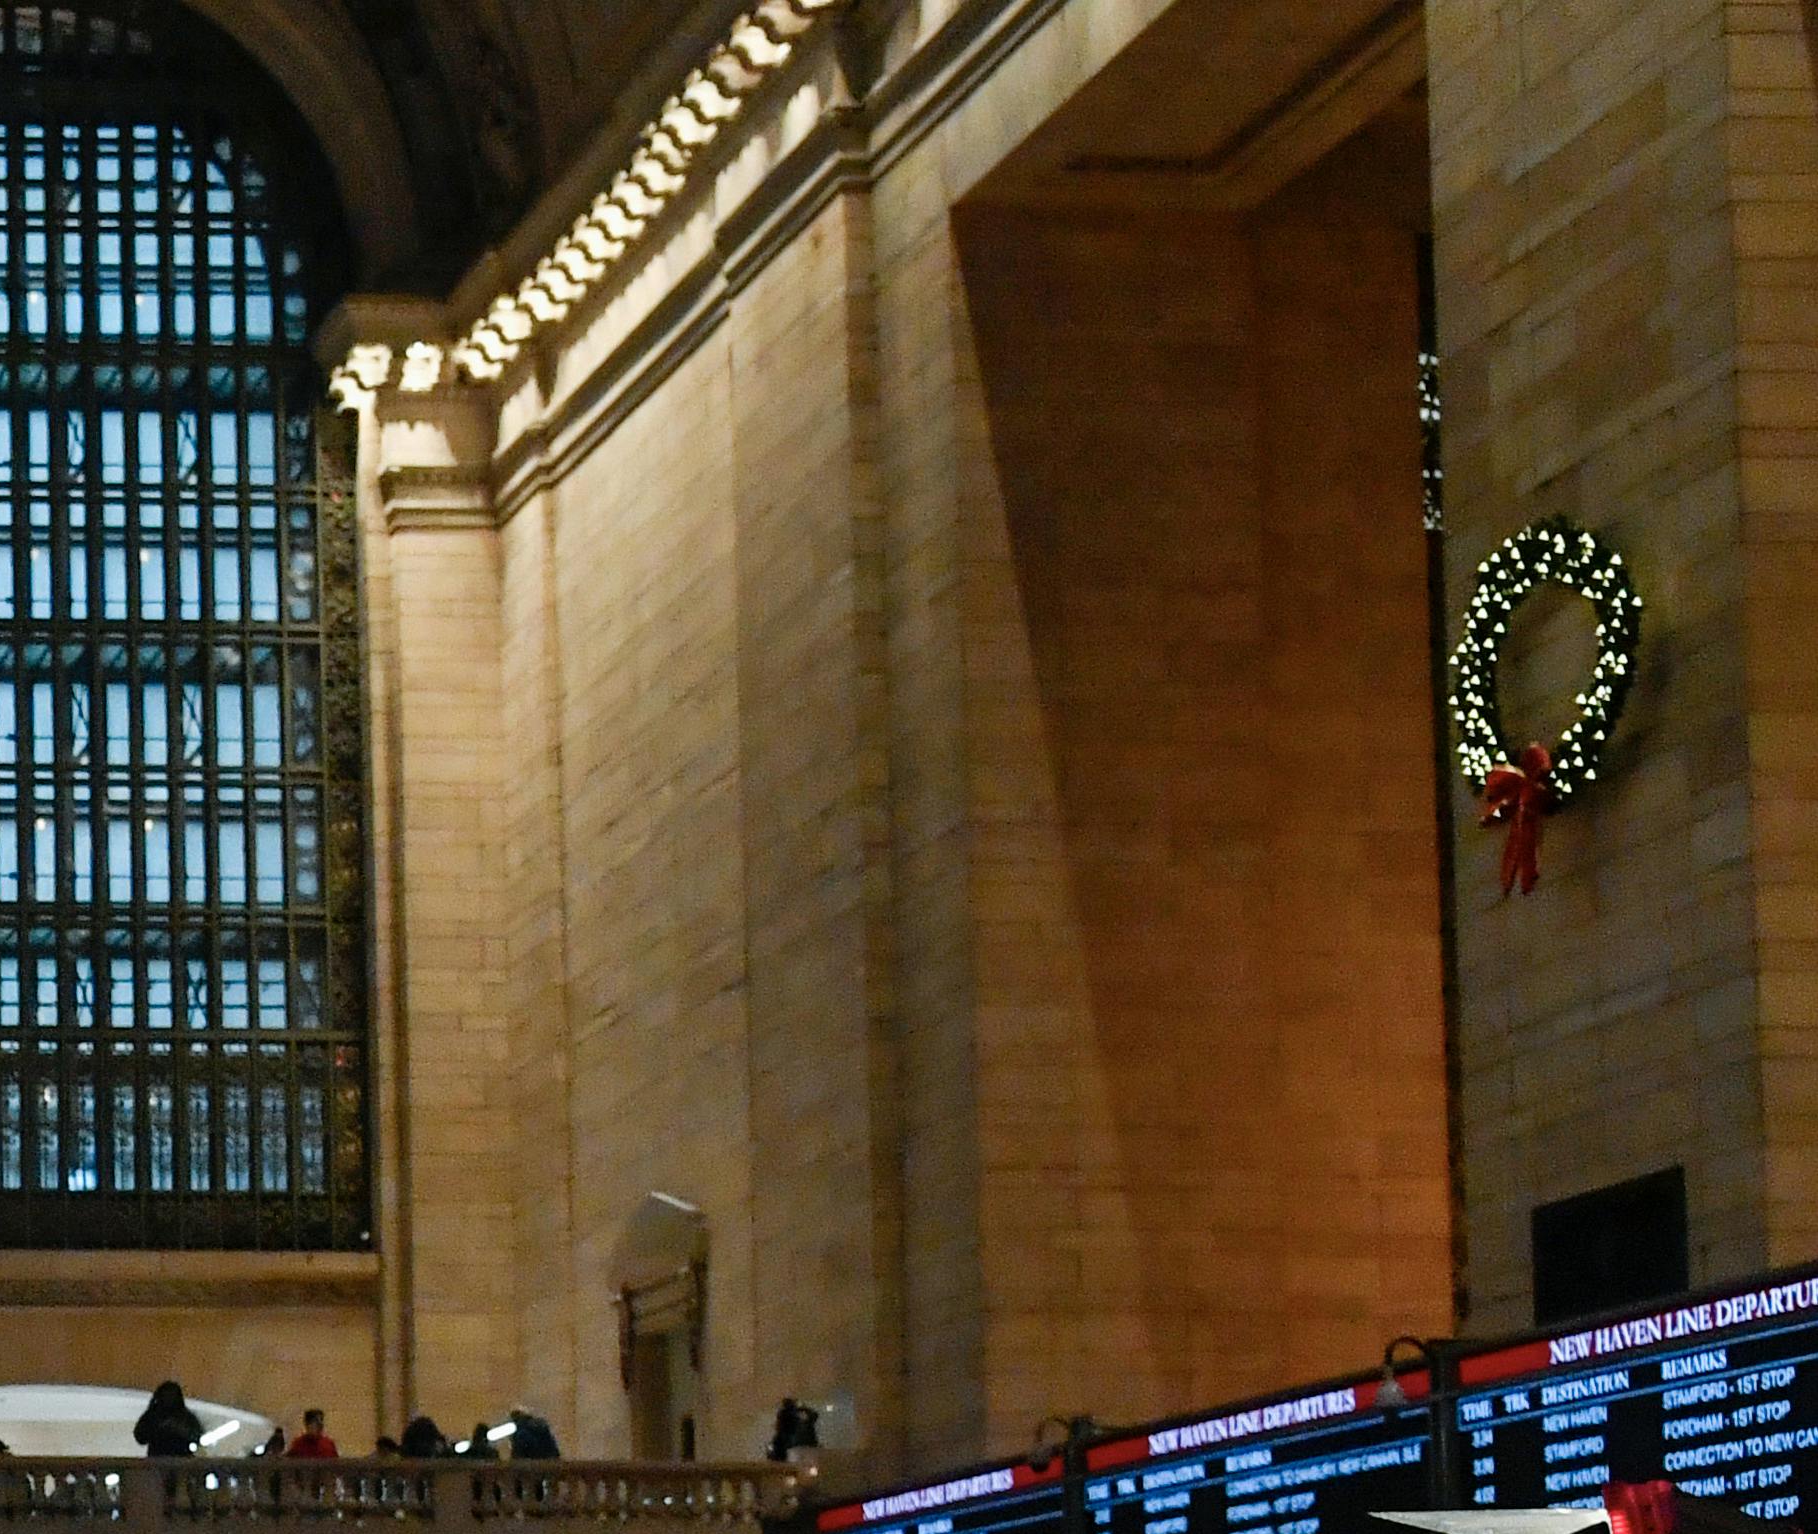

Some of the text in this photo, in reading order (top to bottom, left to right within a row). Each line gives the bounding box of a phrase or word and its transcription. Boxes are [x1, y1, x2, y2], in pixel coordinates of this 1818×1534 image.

[1549, 1332, 1594, 1365] NEW
[1595, 1314, 1663, 1354] HAVEN
[1664, 1304, 1713, 1339] LINE
[1761, 1366, 1795, 1391] STOP
[1756, 1400, 1792, 1424] STOP
[1764, 1496, 1799, 1520] STOP
